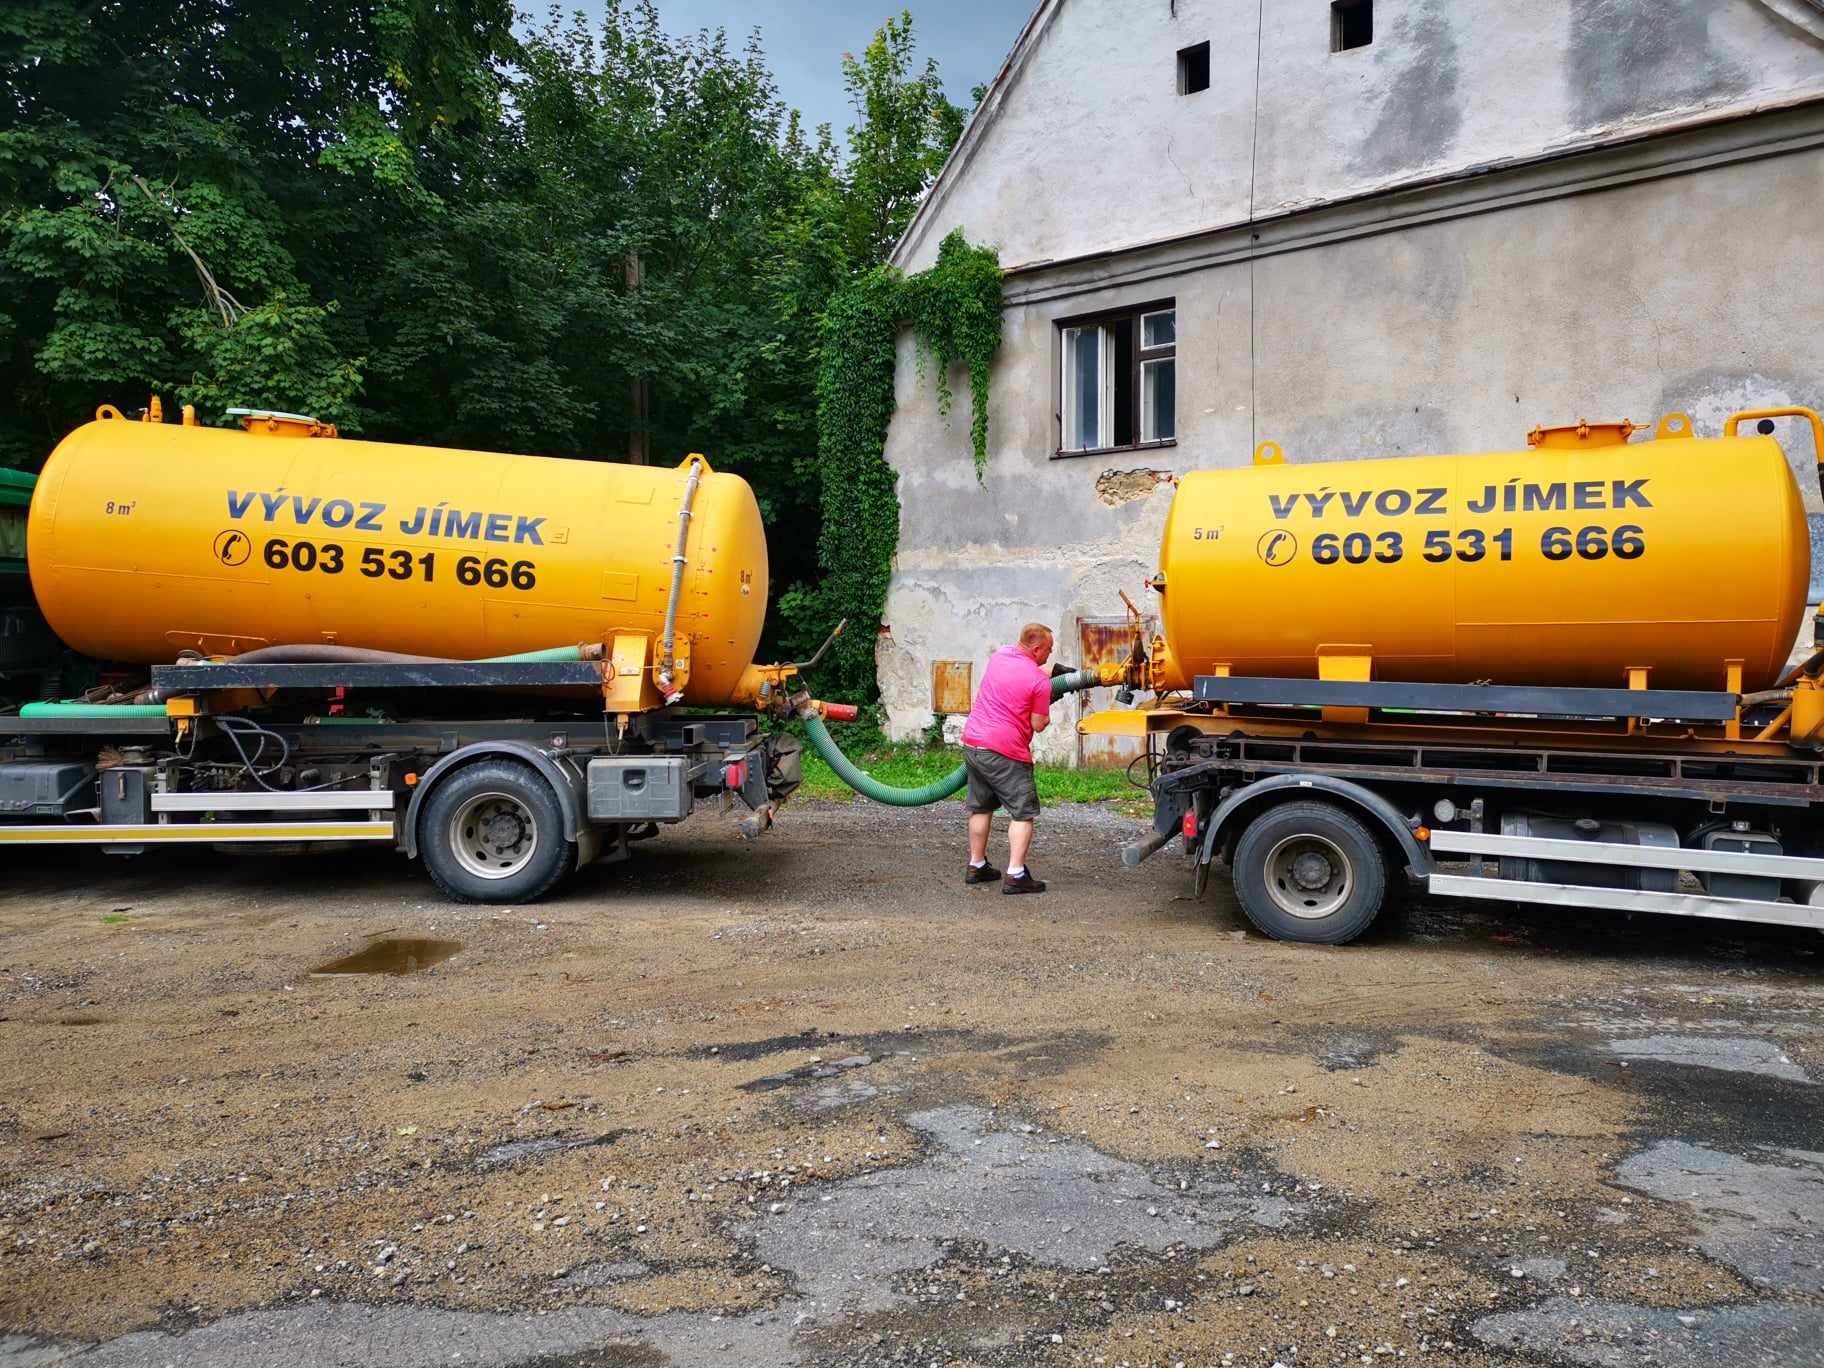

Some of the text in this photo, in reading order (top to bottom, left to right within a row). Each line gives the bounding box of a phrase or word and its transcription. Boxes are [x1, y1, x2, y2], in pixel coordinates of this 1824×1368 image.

[106, 501, 115, 514] 8
[227, 487, 547, 546] VÝVOZ JÍMEK
[1268, 478, 1653, 519] VÝVOZ JÍMEK
[1194, 527, 1203, 540] 5
[1311, 524, 1646, 565] 603 531 666
[264, 539, 536, 590] 603 531 666
